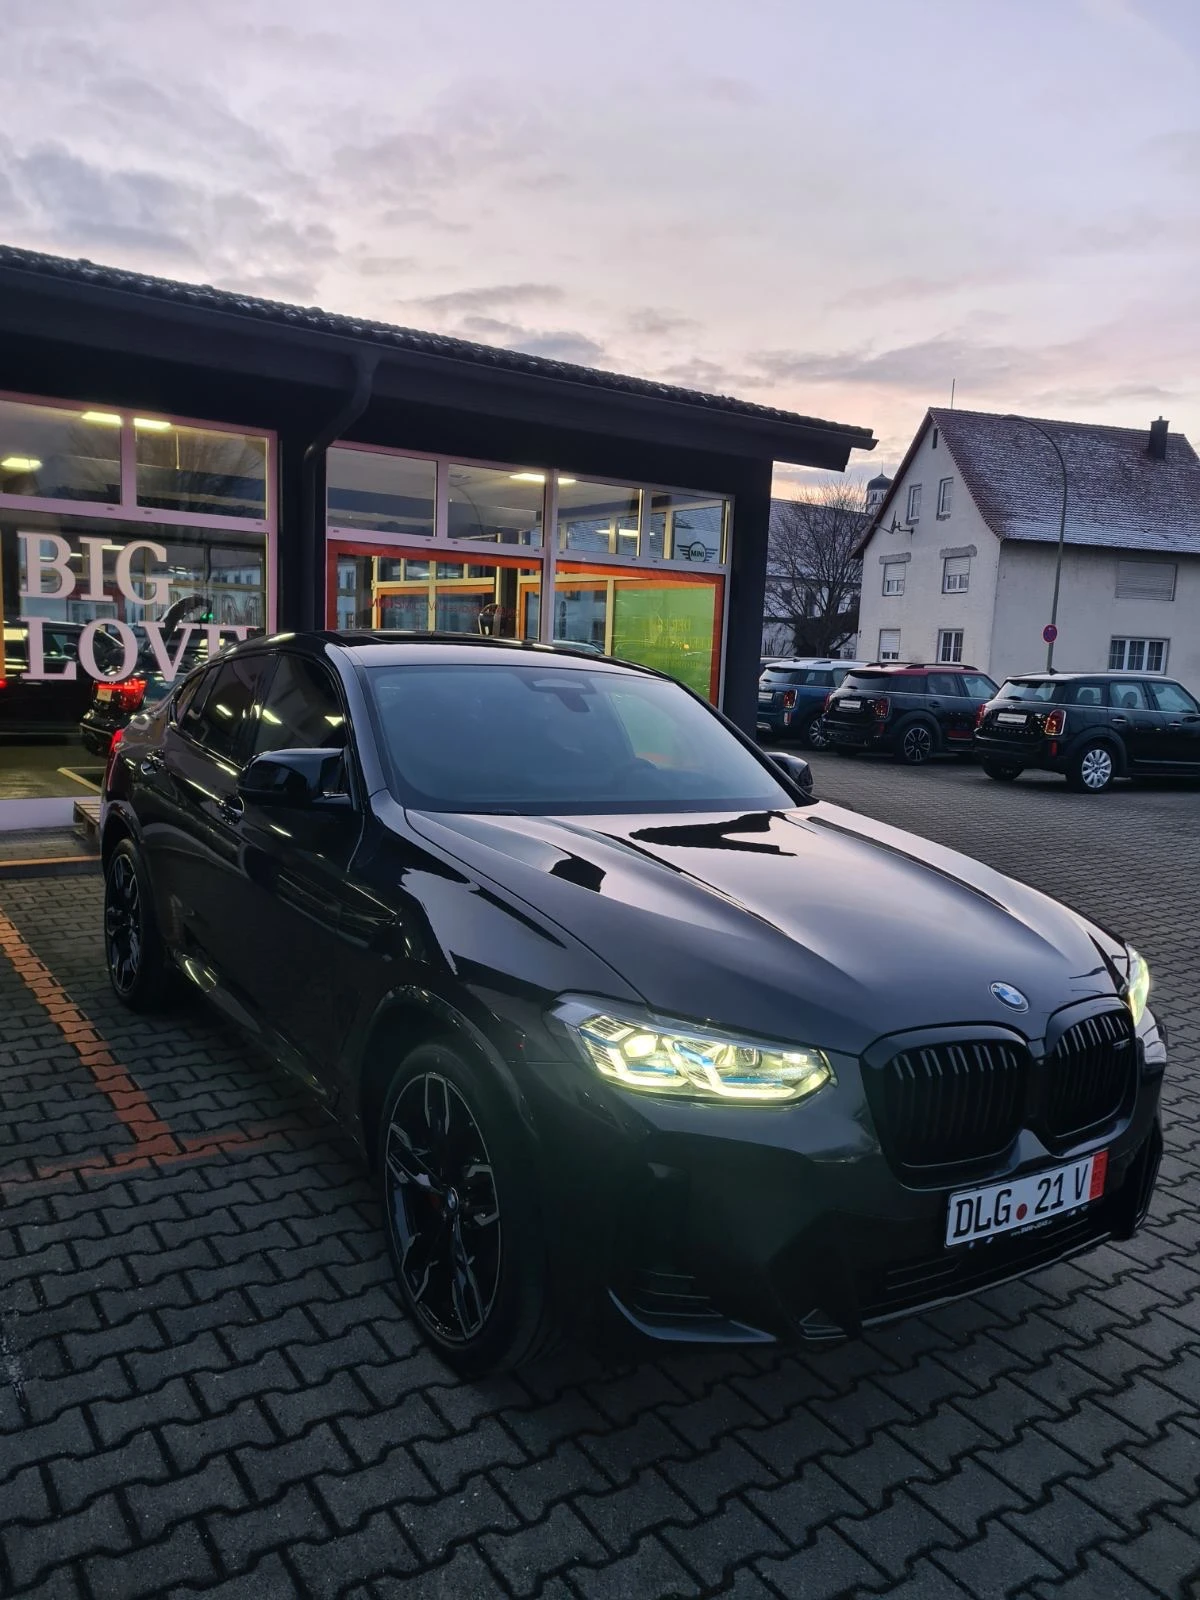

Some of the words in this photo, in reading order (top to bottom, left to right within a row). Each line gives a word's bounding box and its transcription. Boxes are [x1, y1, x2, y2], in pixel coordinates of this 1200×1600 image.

[17, 531, 174, 606] BIG
[690, 549, 705, 558] MINI
[952, 1189, 1012, 1238] DLG
[1034, 1172, 1064, 1216] 21
[1075, 1163, 1089, 1201] V
